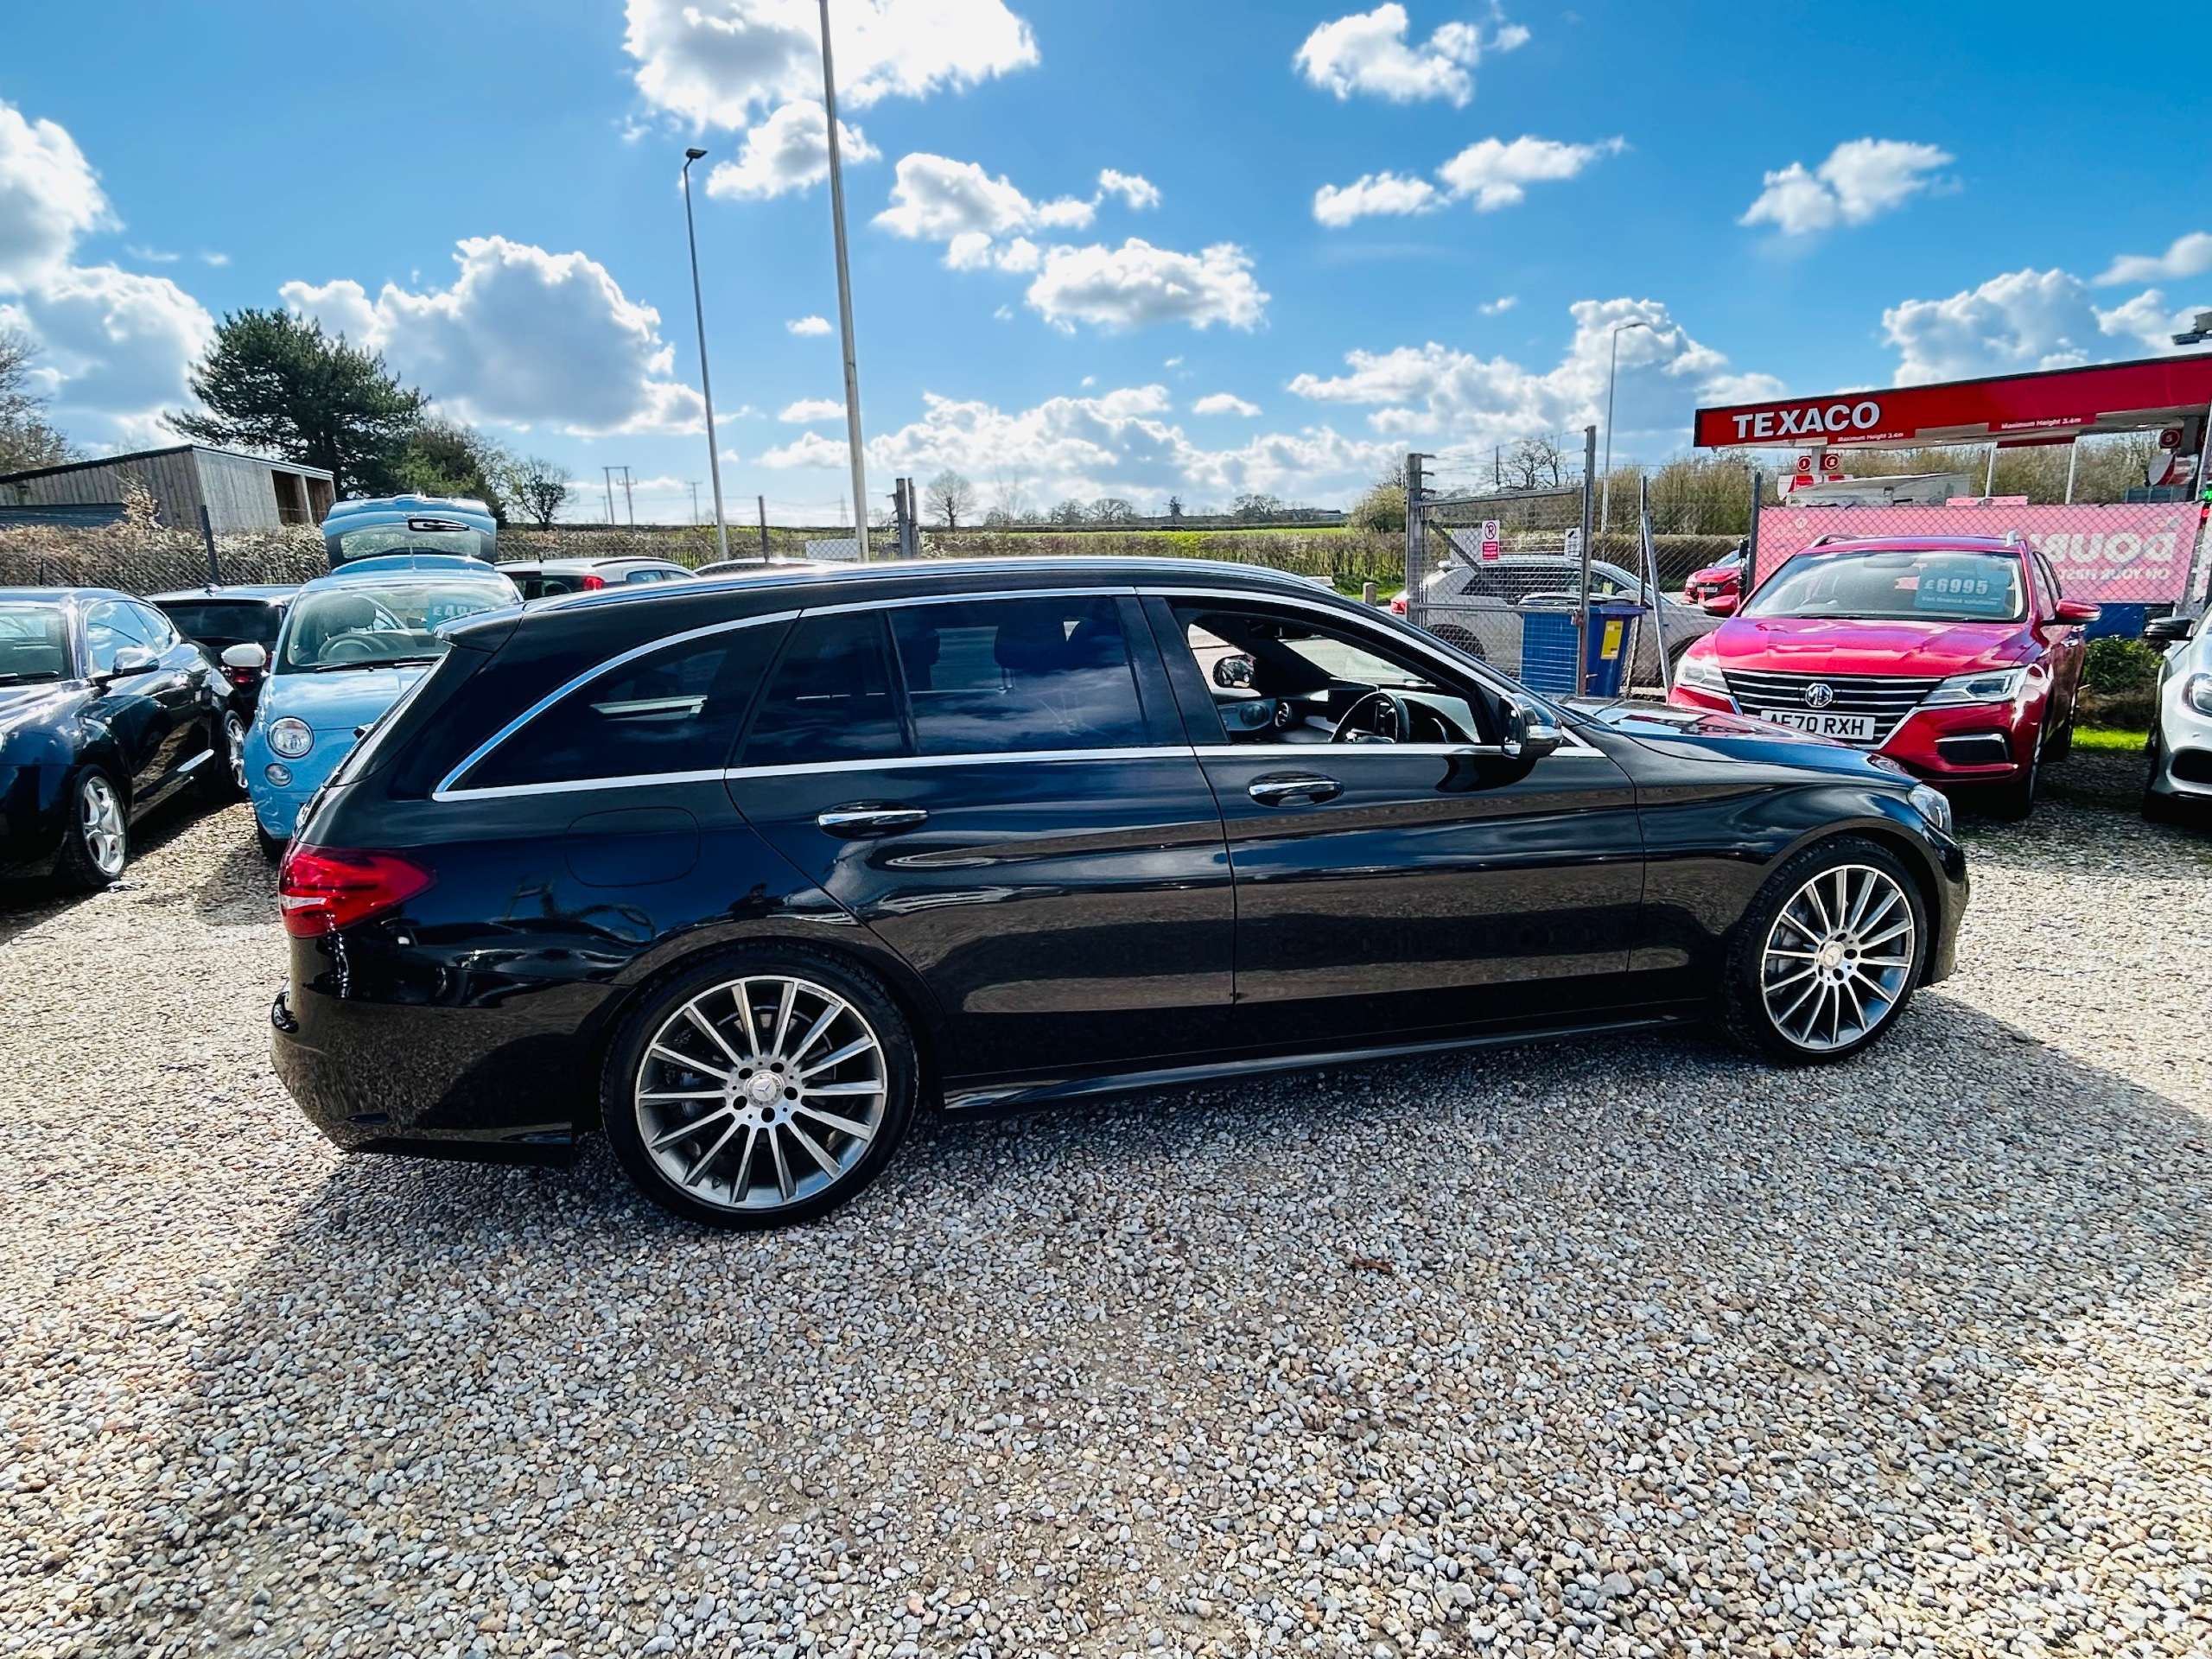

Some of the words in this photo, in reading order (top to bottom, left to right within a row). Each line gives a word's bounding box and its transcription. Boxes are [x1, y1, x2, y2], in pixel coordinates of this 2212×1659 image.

[1732, 401, 1880, 439] TEXACO
[1923, 577, 1988, 594] £6995
[1823, 717, 1865, 735] RXH
